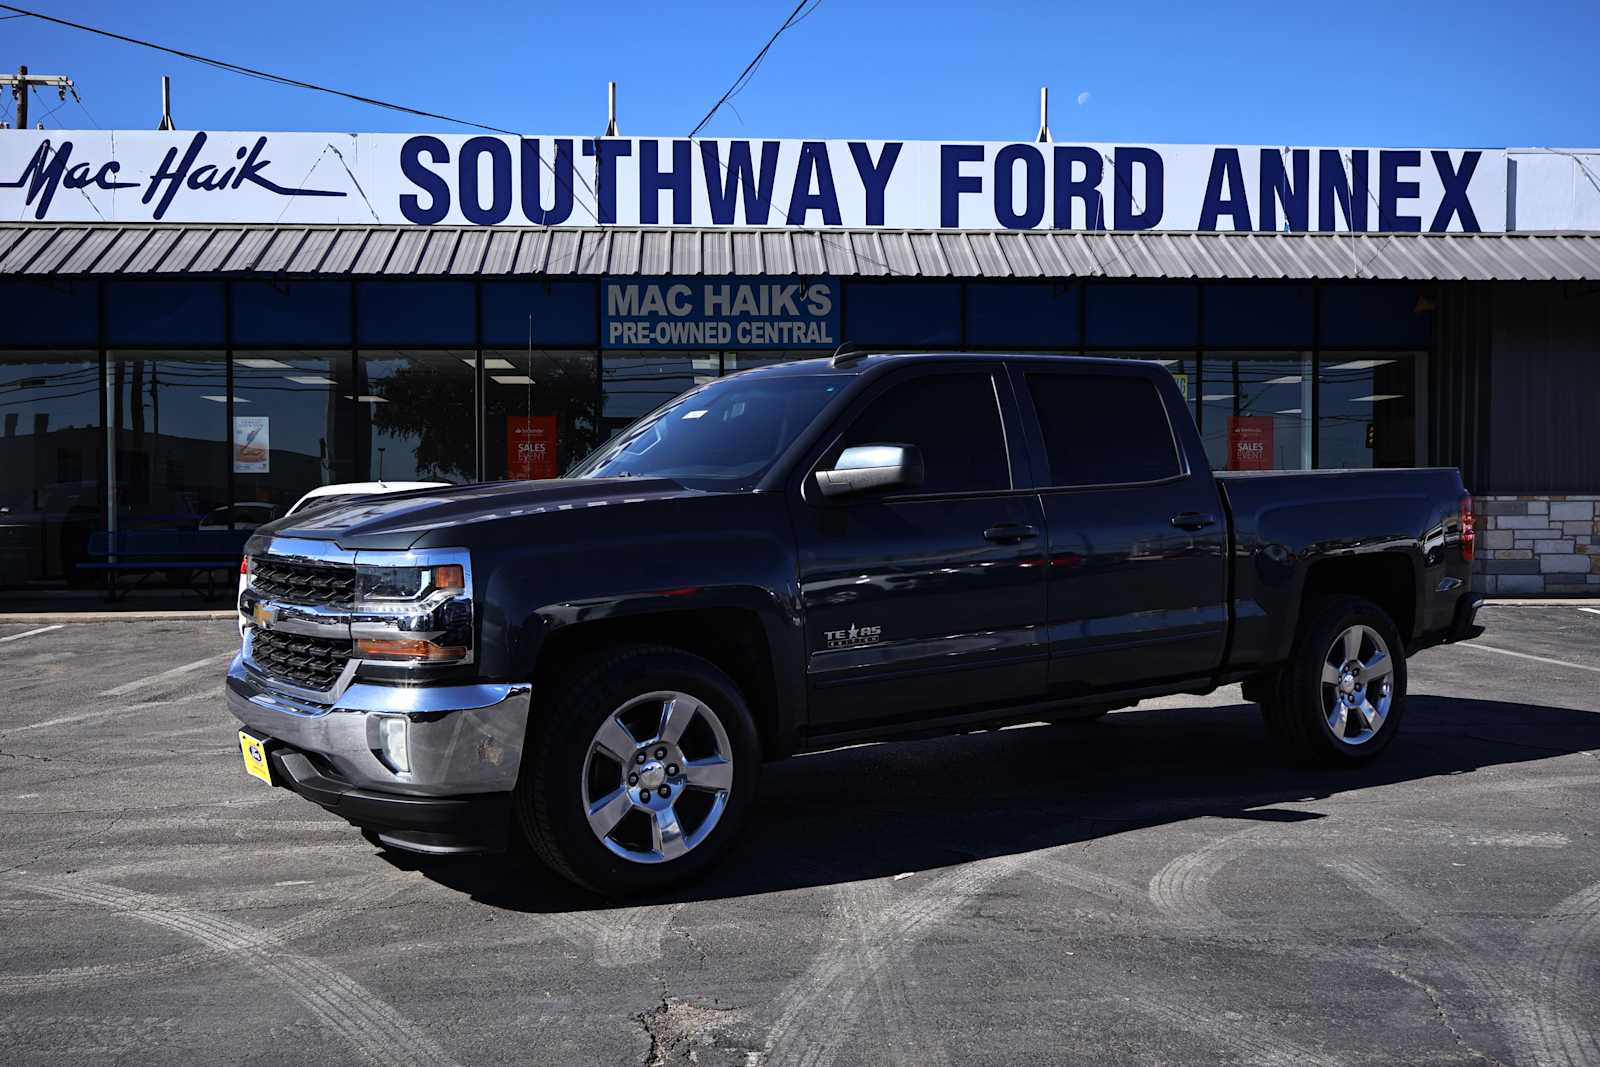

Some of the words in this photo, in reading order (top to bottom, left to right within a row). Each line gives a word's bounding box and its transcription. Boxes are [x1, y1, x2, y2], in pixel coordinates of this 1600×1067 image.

[0, 139, 141, 220] Mac
[141, 131, 347, 220] Haik
[399, 135, 904, 226] SOUTHWAY
[939, 143, 1165, 231] FORD
[1197, 147, 1483, 233] ANNEX
[607, 283, 693, 317] MAC
[703, 283, 833, 317] HAIK'S
[609, 321, 732, 345] PRE-OWNED
[736, 321, 833, 345] CENTRAL
[517, 443, 546, 452] SALES
[1237, 442, 1264, 451] SALES
